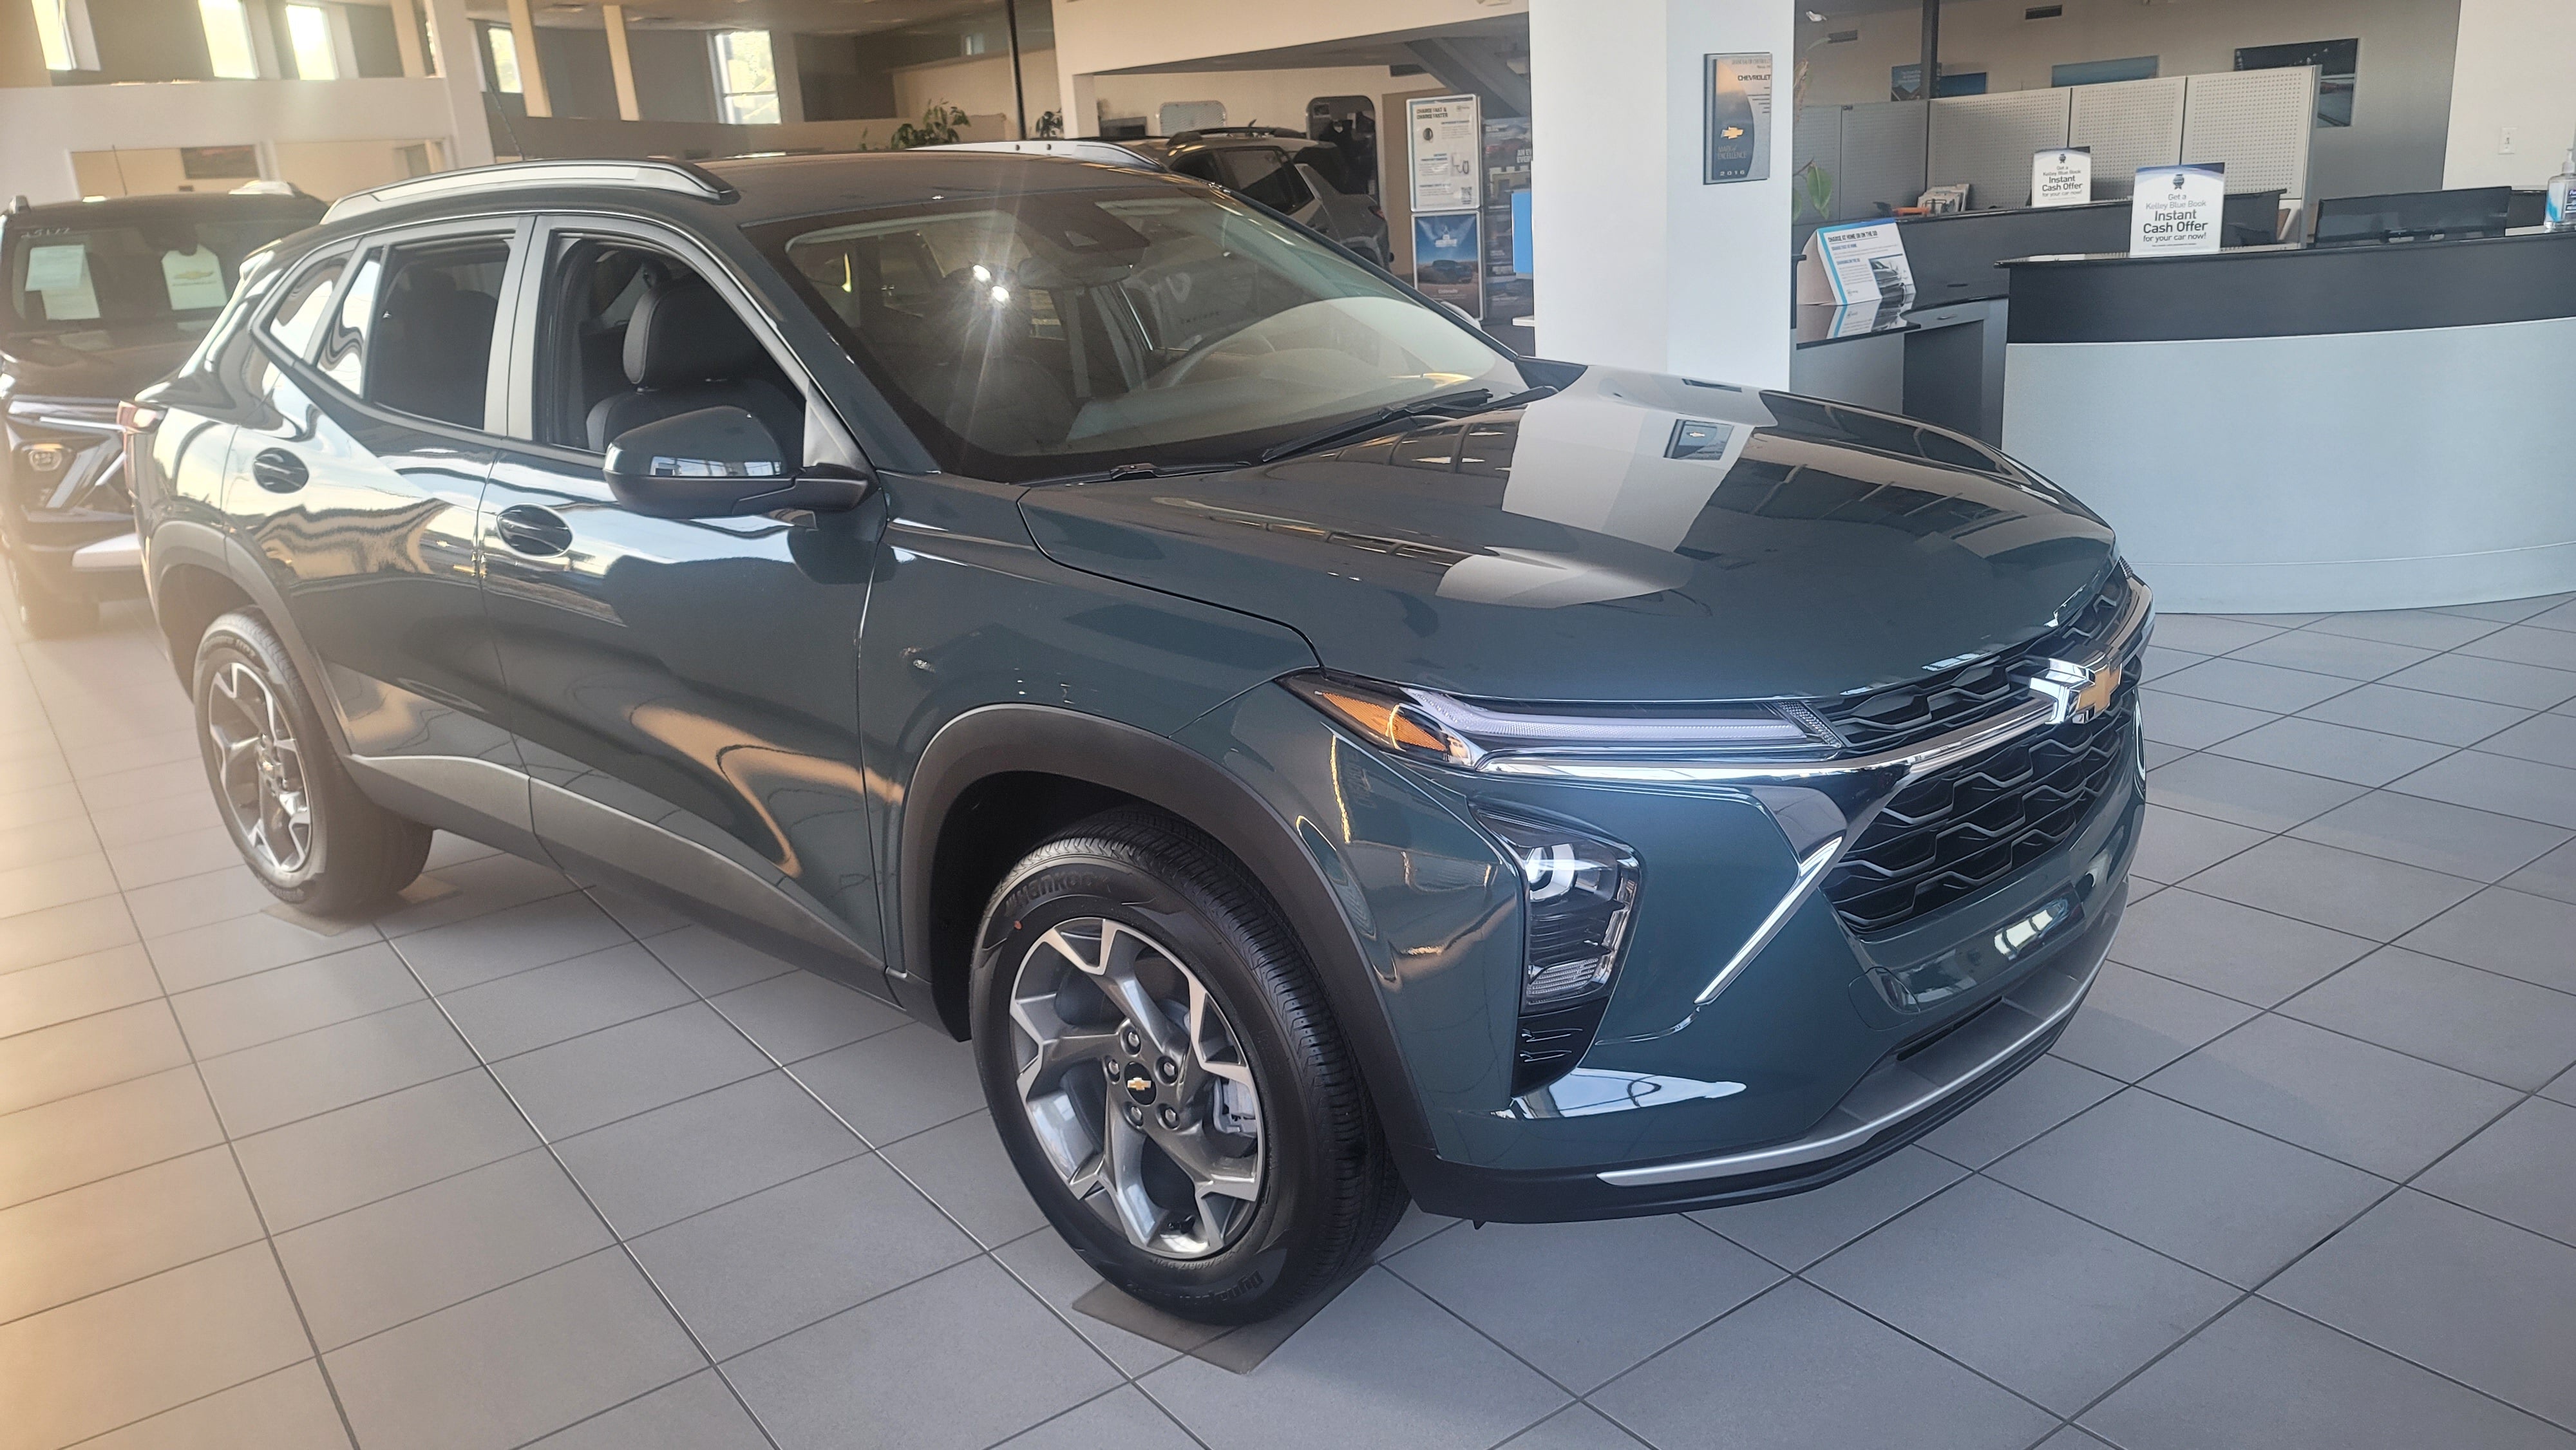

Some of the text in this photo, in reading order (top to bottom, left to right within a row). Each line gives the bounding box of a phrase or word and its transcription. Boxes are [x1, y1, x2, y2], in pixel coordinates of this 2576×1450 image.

[2049, 174, 2076, 184] Instant
[2042, 182, 2083, 192] Cash Offer
[2146, 202, 2168, 211] Kelley
[2154, 209, 2197, 221] Instant
[2143, 220, 2209, 234] Cash Offer
[2155, 234, 2173, 243] your
[2188, 232, 2206, 240] now!
